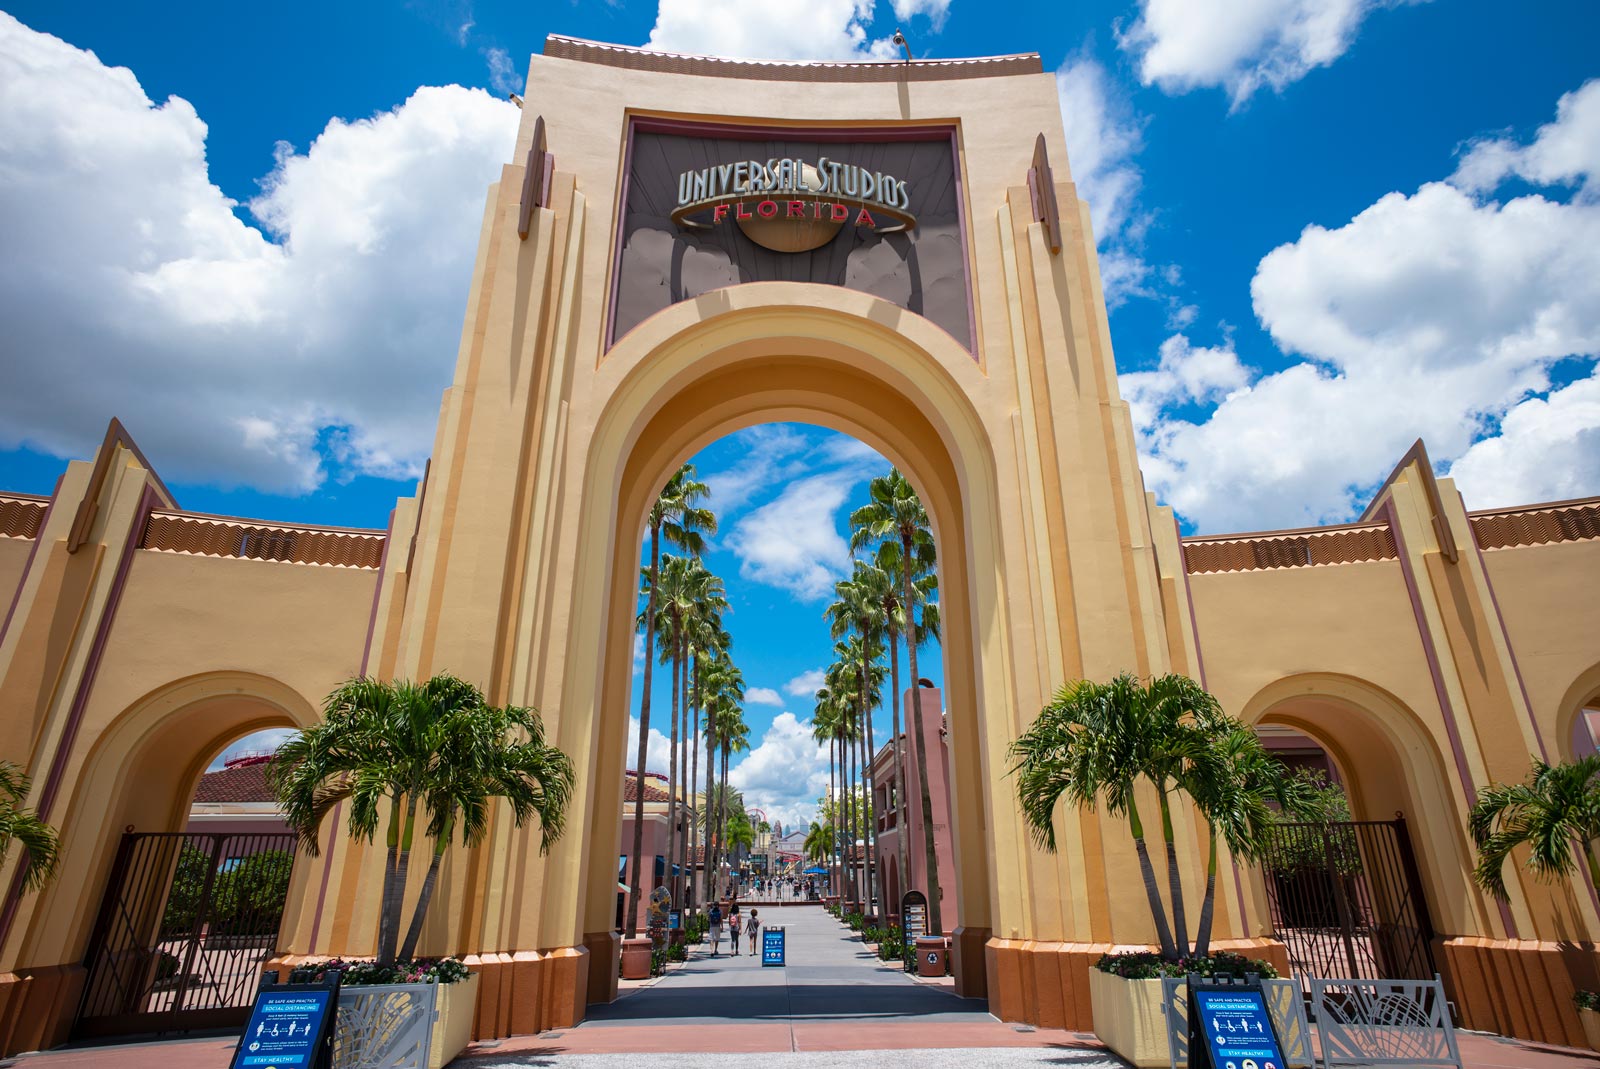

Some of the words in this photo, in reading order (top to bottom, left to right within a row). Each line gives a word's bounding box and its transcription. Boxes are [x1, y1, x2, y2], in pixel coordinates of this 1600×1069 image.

[678, 158, 809, 205] UNIVERSAL
[816, 157, 910, 210] STUDIOS
[713, 201, 876, 228] FLORIDA
